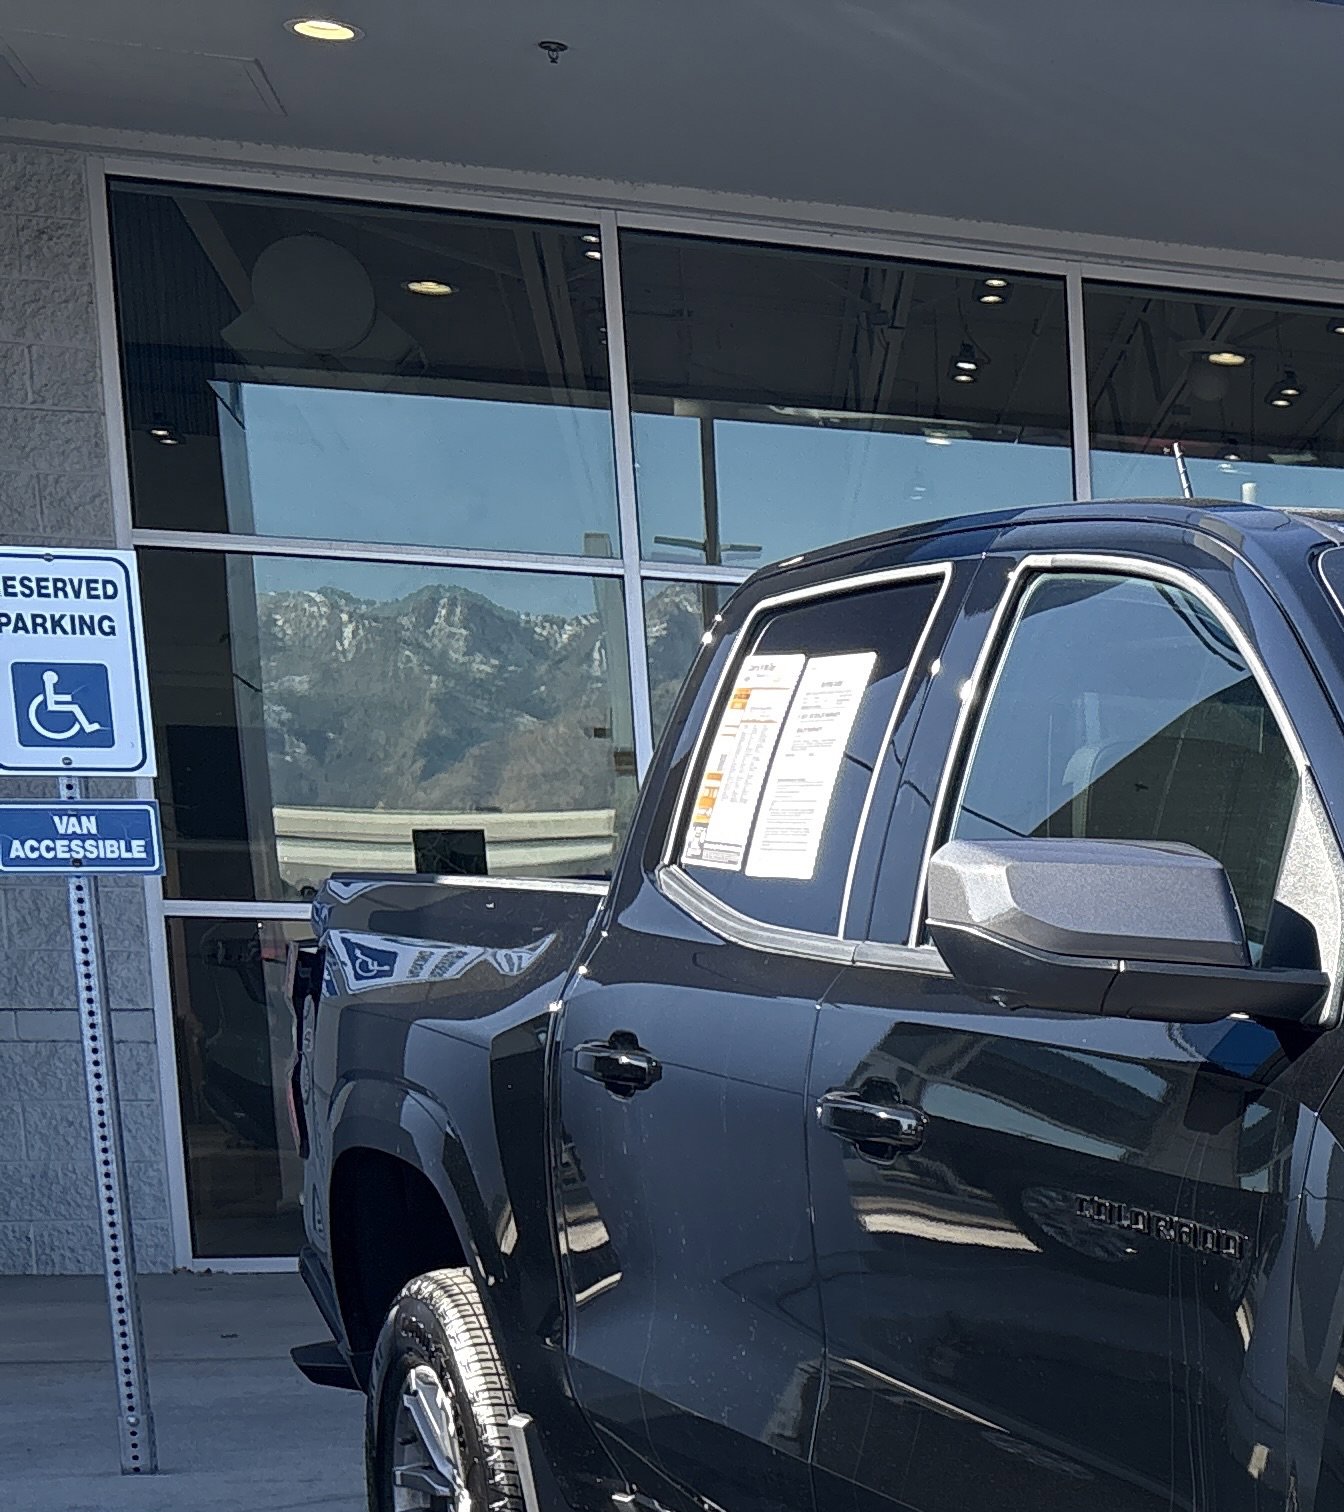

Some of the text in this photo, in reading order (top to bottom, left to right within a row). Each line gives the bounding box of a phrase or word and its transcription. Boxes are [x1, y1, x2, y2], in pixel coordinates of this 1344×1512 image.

[0, 575, 118, 600] ESERVED
[0, 612, 117, 637] PARKING
[52, 815, 98, 835] VAN
[9, 839, 147, 859] ACCESSIBLE
